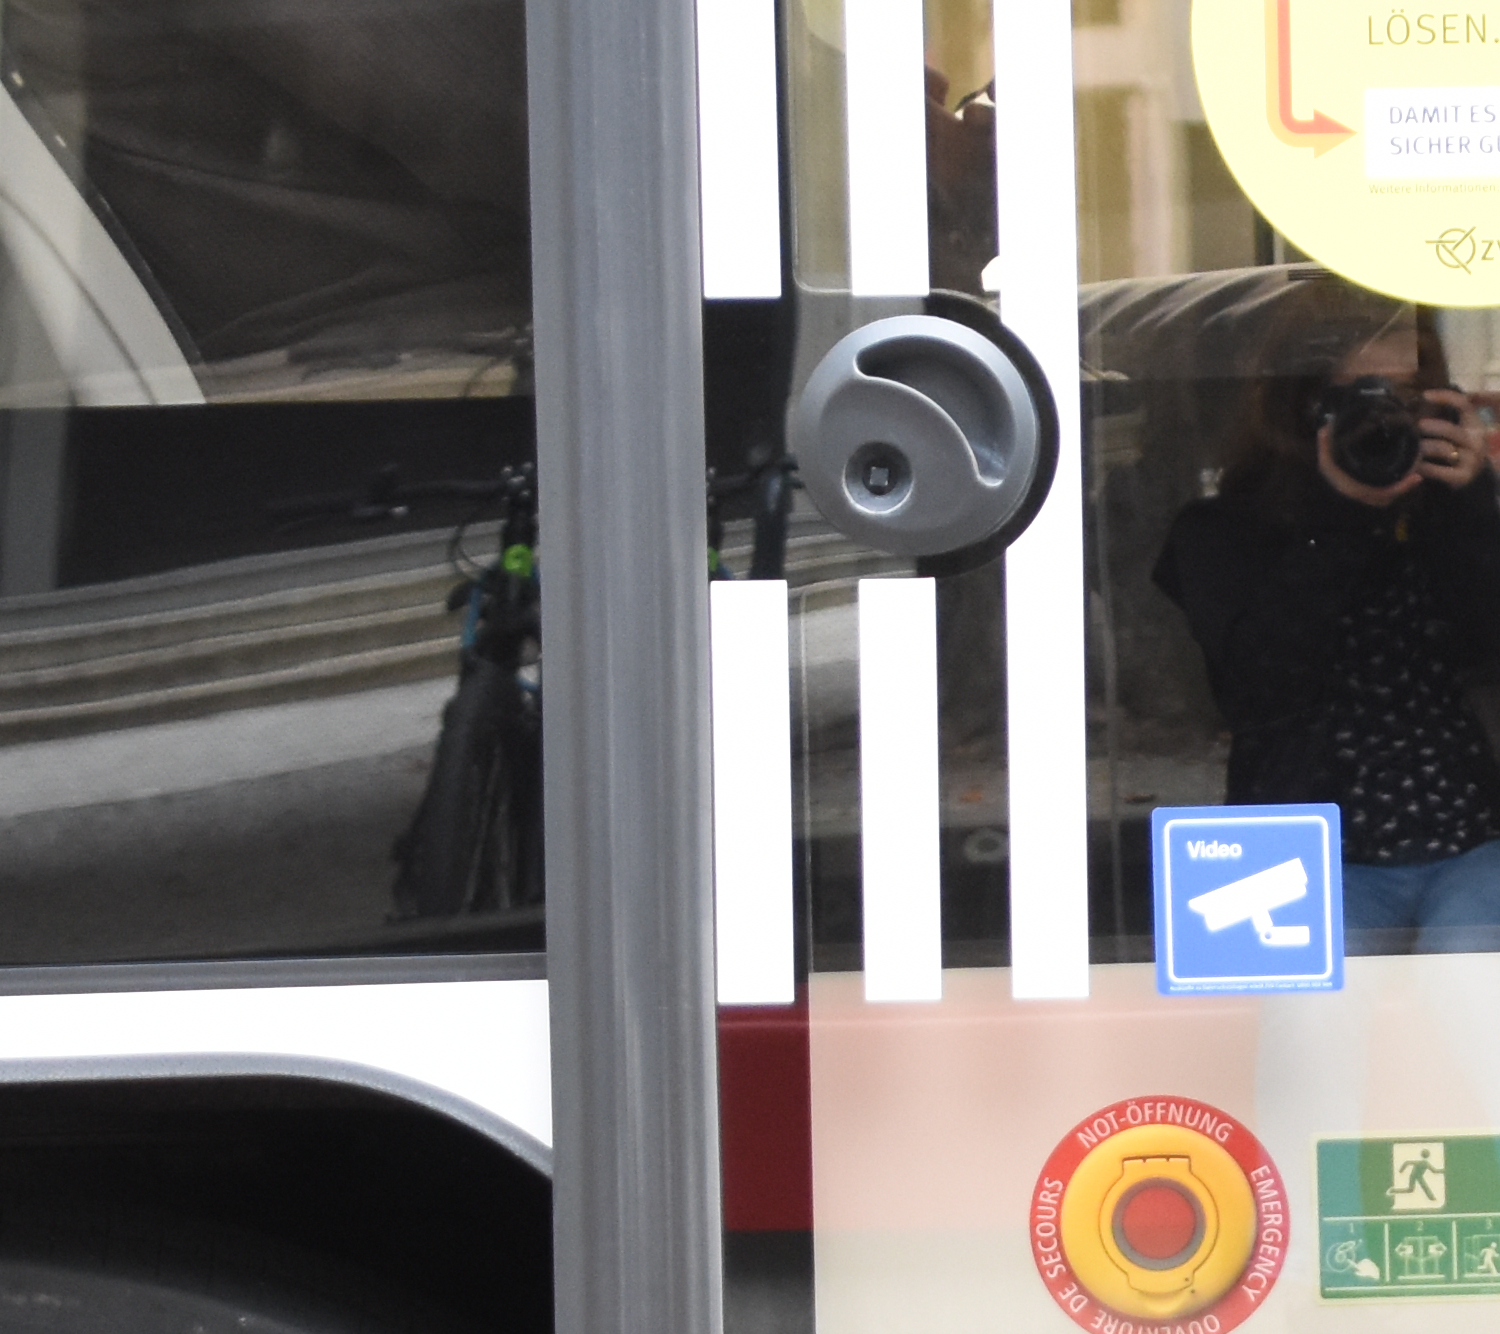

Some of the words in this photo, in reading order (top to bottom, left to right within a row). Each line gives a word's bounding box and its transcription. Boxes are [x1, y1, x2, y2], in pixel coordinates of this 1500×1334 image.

[1368, 8, 1500, 45] LÖSEN.
[1389, 105, 1462, 124] DAMIT
[1470, 104, 1496, 123] ES
[1390, 136, 1471, 155] SICHER
[1369, 183, 1412, 194] Weitere
[1415, 182, 1499, 194] Informationen:
[1187, 840, 1243, 858] Video
[1077, 1101, 1233, 1148] NOT-ÖFFNUNG
[1036, 1177, 1066, 1278] SECOURS
[1242, 1165, 1283, 1302] EMERGENCY
[1417, 1221, 1424, 1231] 2
[1486, 1219, 1492, 1230] 3
[1059, 1283, 1088, 1313] DE
